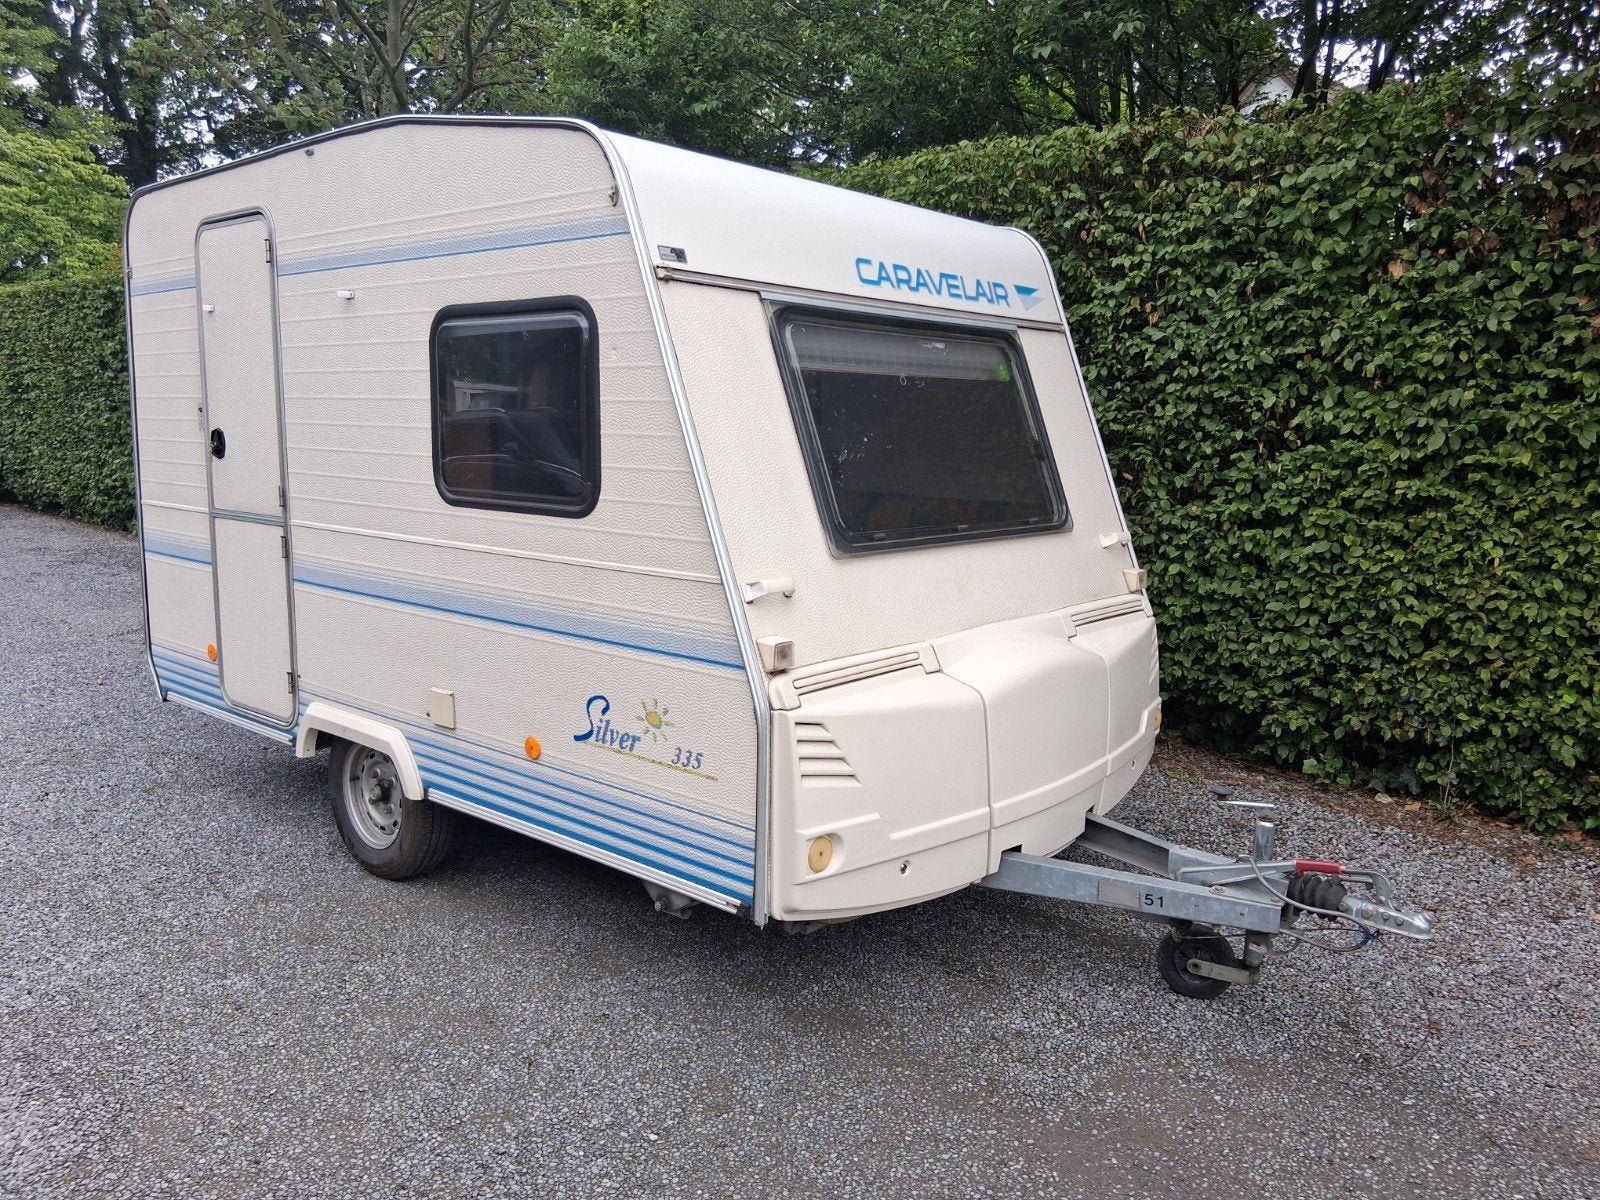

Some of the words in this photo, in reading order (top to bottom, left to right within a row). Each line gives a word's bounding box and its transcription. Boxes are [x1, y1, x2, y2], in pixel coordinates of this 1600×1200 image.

[855, 257, 1011, 307] CARAVELAIR
[573, 694, 641, 752] Silver
[671, 747, 703, 769] 335
[1144, 893, 1164, 908] 51
